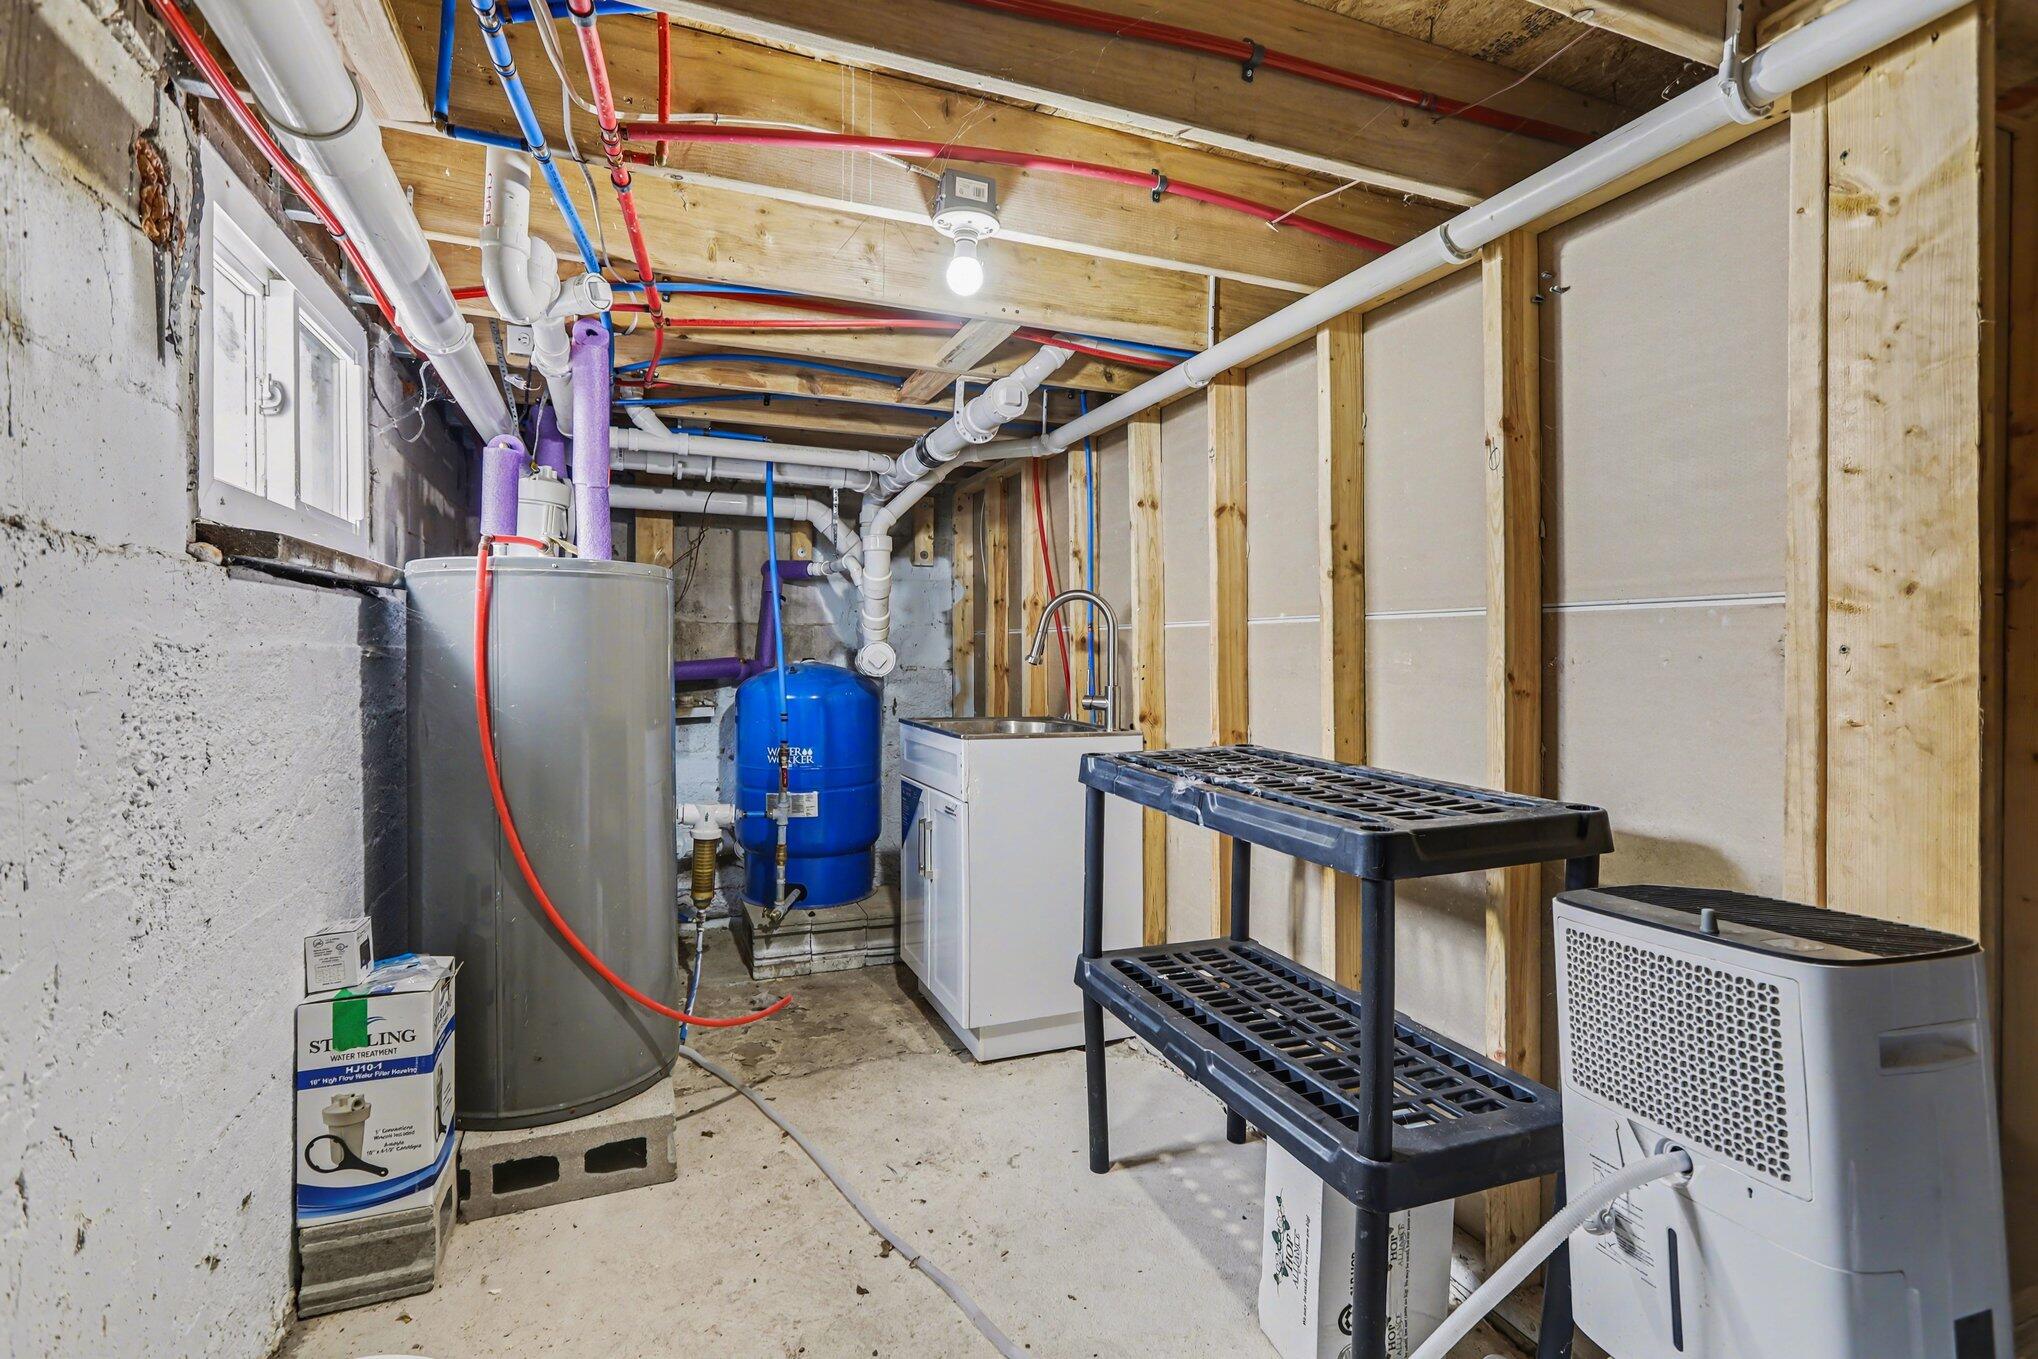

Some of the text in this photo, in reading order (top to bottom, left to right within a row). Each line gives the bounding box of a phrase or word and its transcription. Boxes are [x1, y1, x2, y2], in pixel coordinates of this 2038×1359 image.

[766, 754, 815, 764] WKER
[309, 1029, 417, 1055] STLING
[330, 1047, 398, 1062] WATER TREATMENT
[322, 1077, 338, 1085] High
[391, 1067, 418, 1076] Housing
[345, 1062, 383, 1074] HJ10-1
[1285, 1233, 1294, 1272] HOP
[1292, 1229, 1301, 1291] ALLIANCE
[1388, 1325, 1396, 1351] HOP
